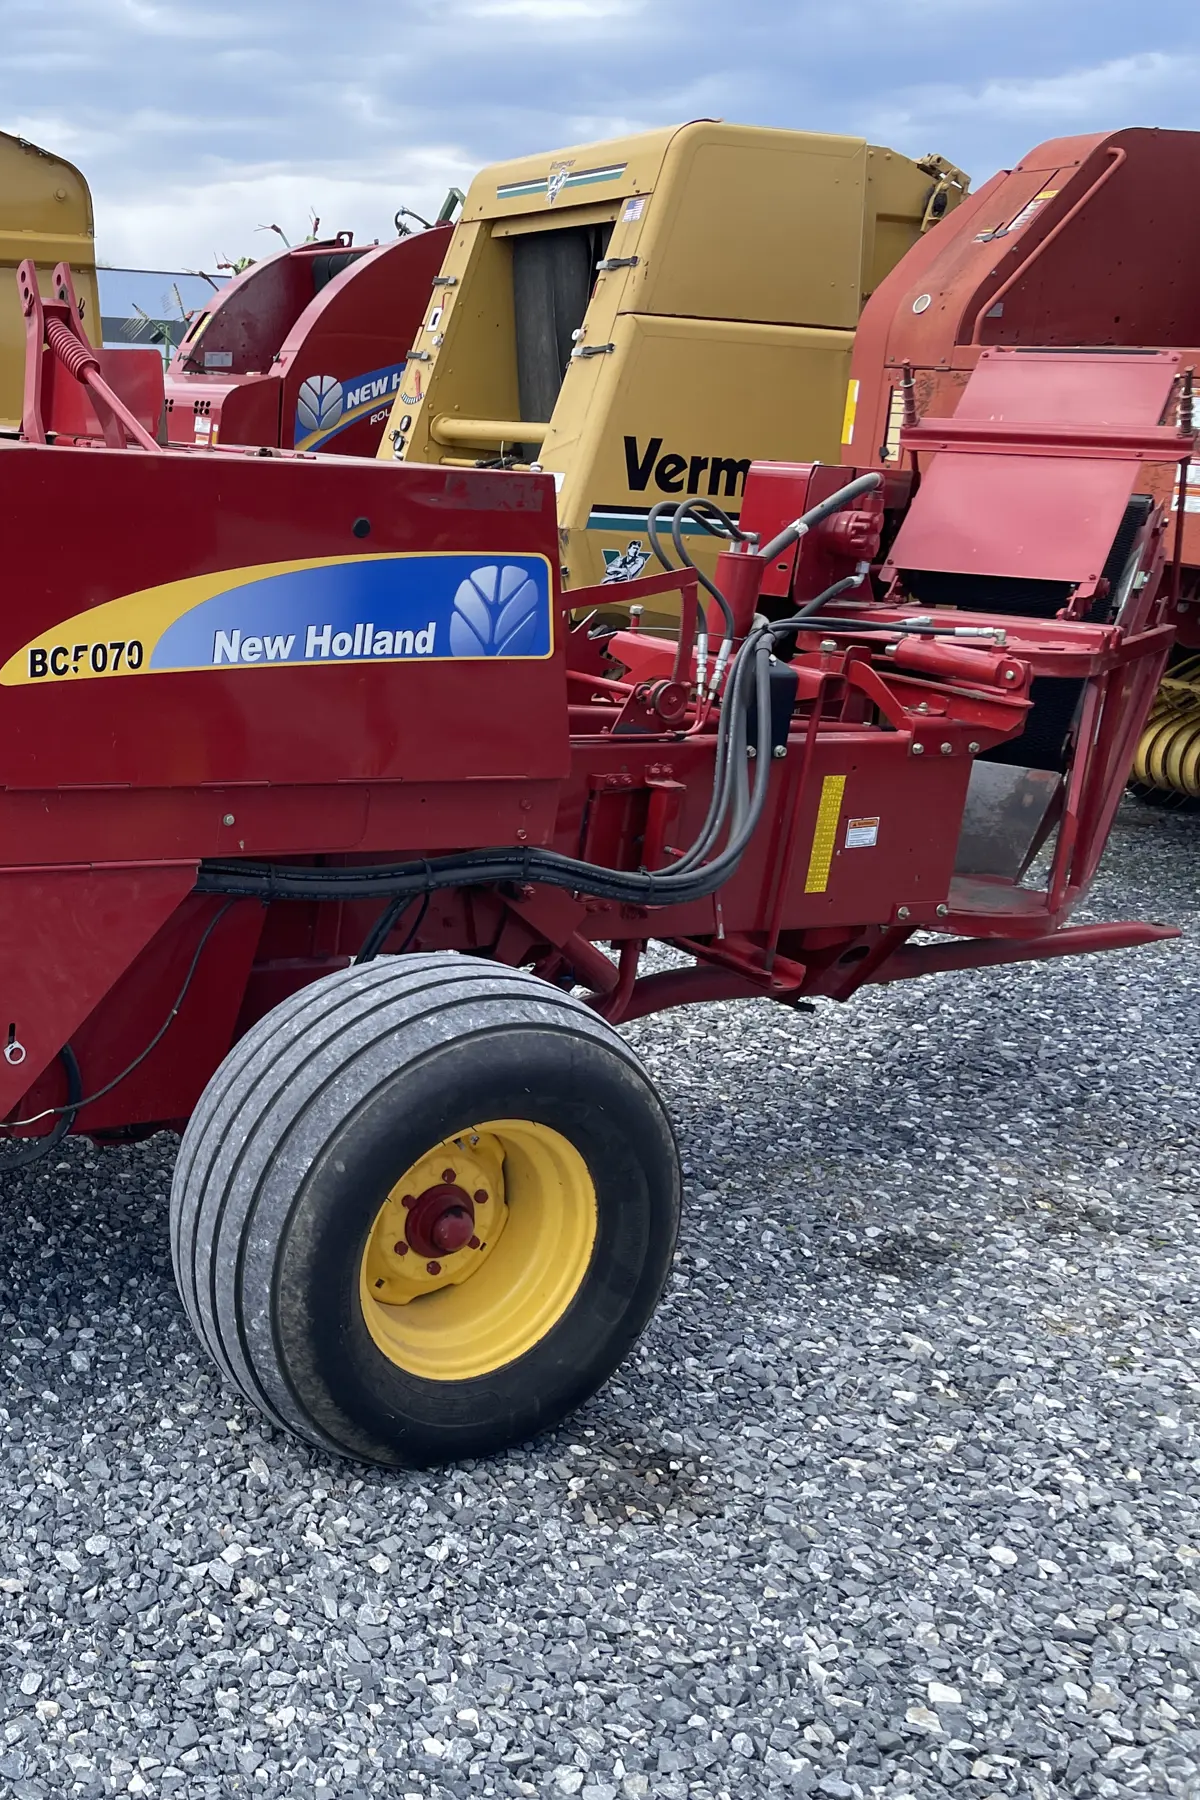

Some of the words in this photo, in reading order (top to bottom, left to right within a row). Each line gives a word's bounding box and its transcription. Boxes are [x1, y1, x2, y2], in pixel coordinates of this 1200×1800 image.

[347, 376, 388, 409] NEW
[624, 436, 752, 498] Verm
[212, 629, 296, 664] New
[305, 622, 437, 658] Holland
